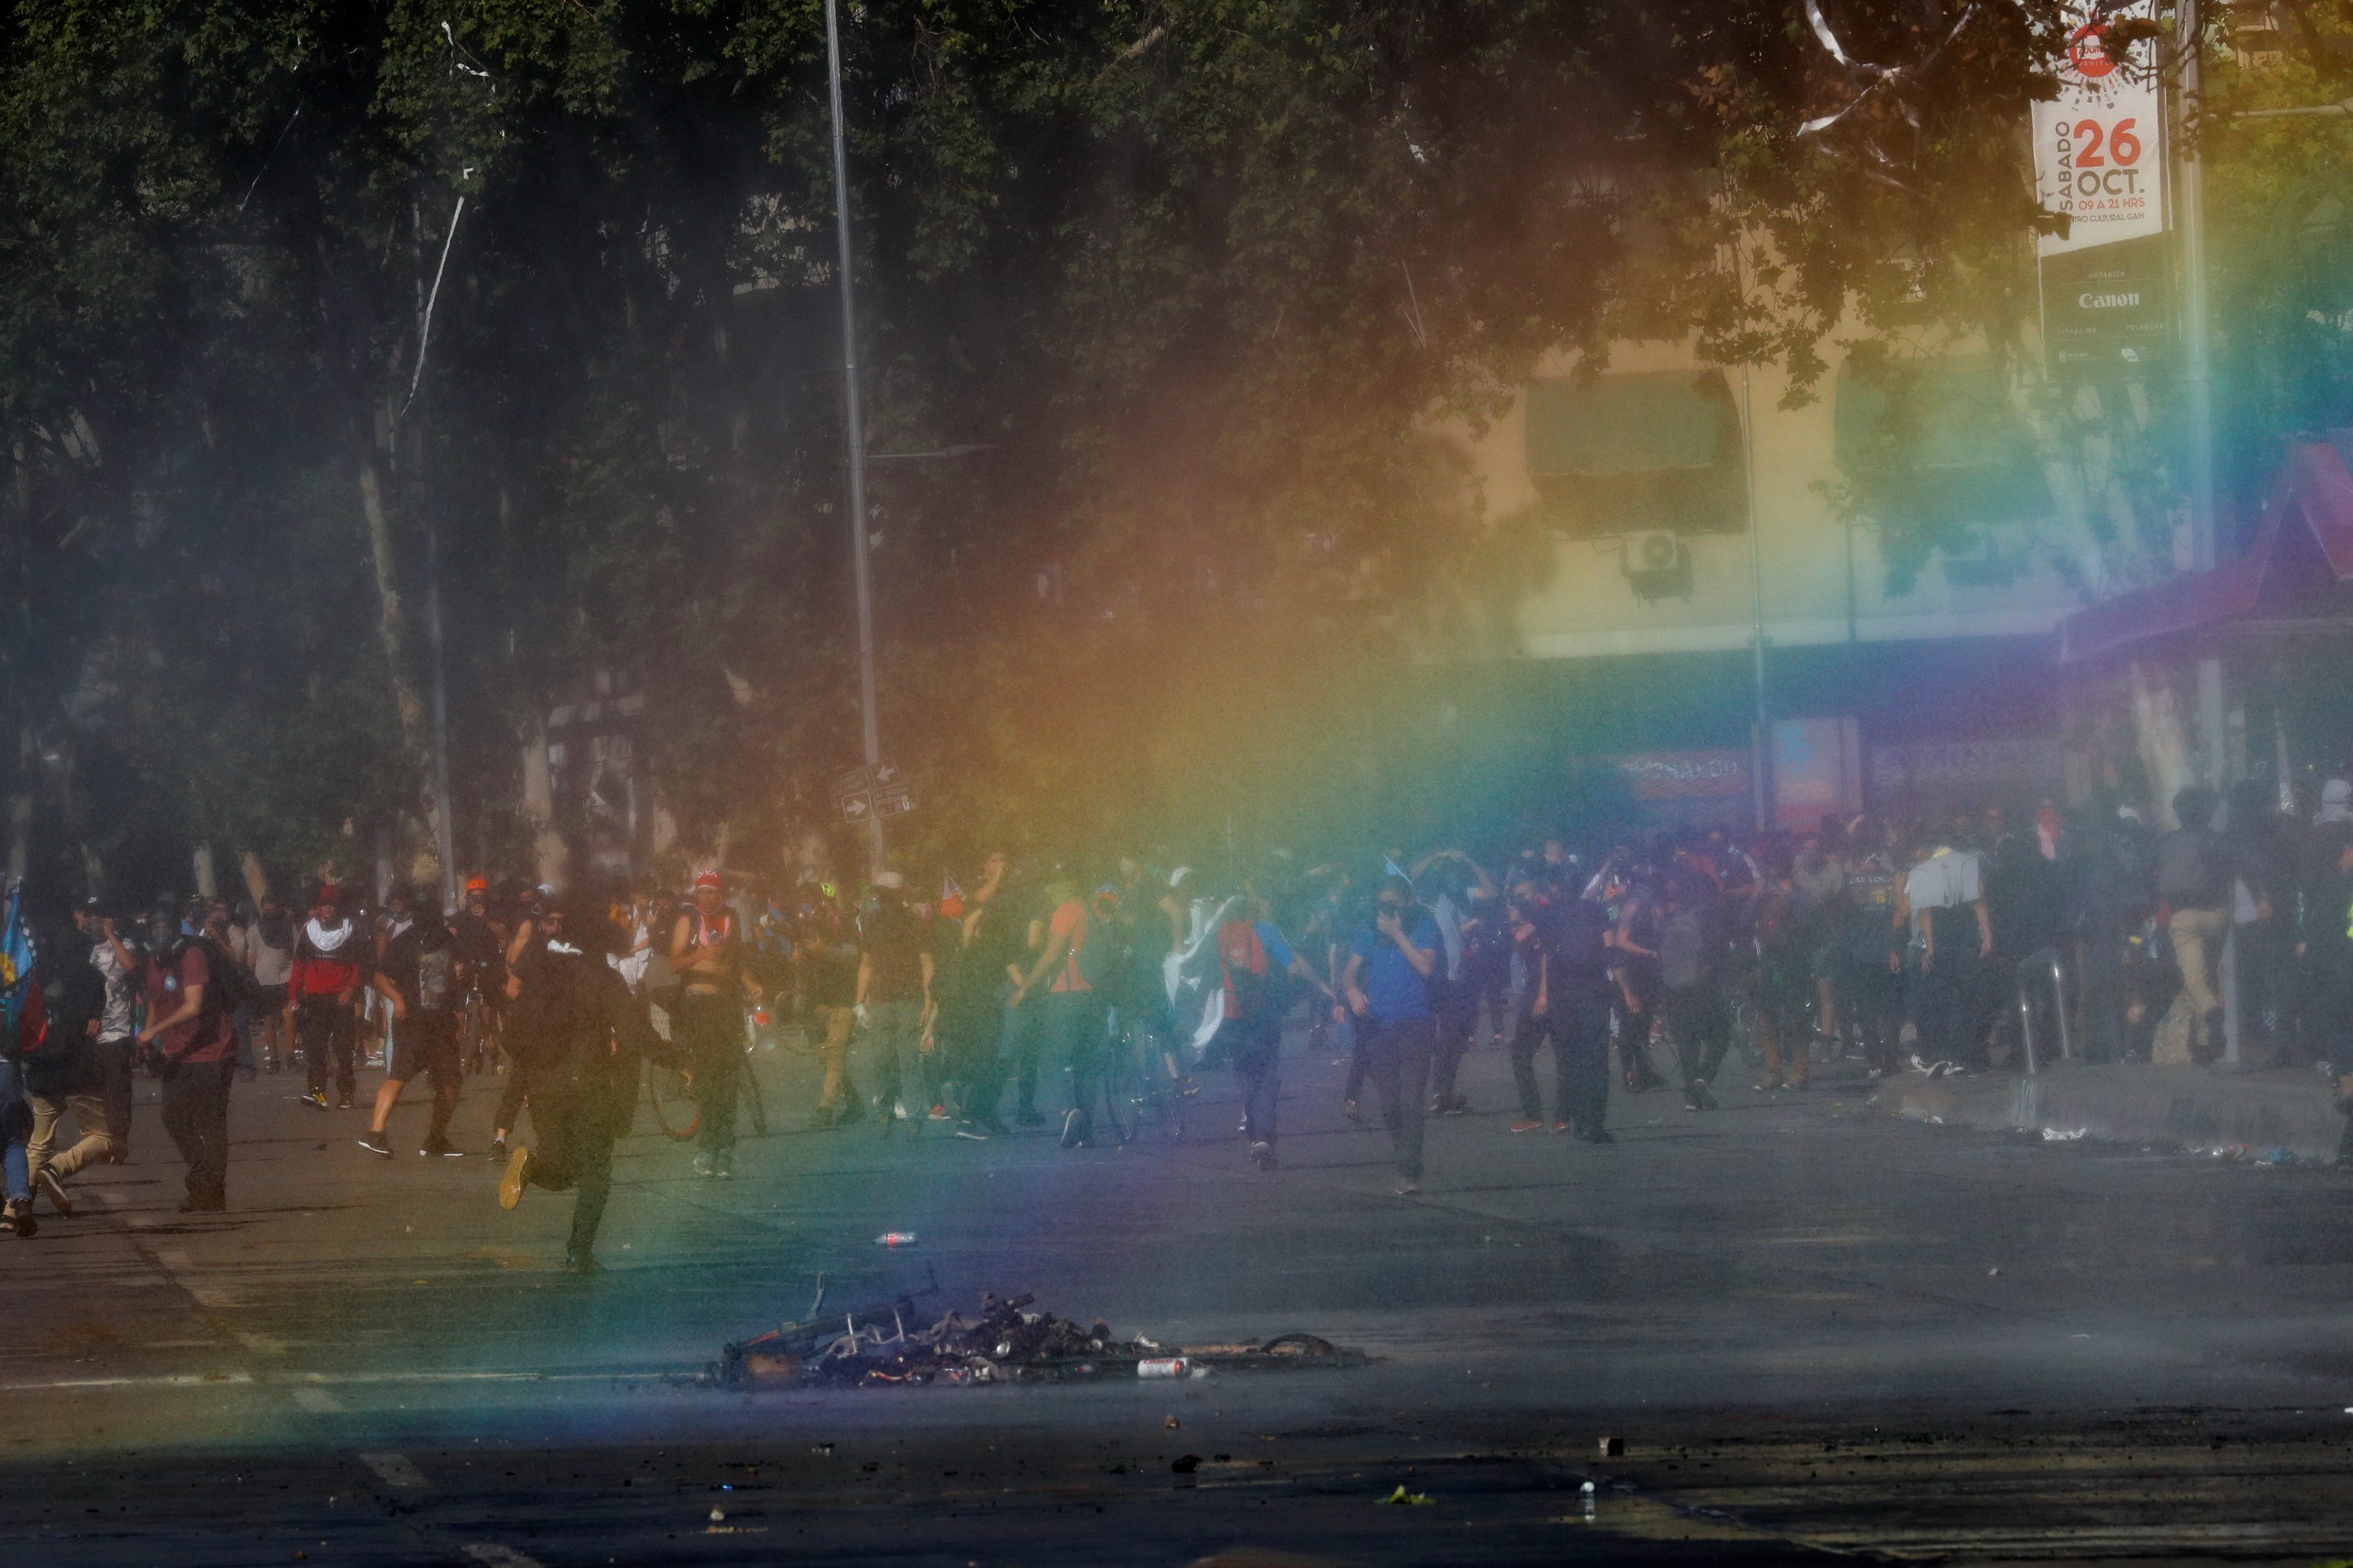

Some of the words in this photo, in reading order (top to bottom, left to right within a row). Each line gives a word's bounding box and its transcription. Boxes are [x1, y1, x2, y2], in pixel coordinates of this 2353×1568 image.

[2073, 118, 2141, 168] 26
[2055, 121, 2073, 211] SABADO
[2078, 168, 2145, 196] OCT.
[2078, 200, 2094, 211] 09
[2097, 199, 2105, 209] A
[2108, 199, 2120, 209] 21
[2123, 197, 2145, 208] HRS
[2090, 214, 2125, 222] CULTURAL
[2078, 293, 2139, 309] Canon
